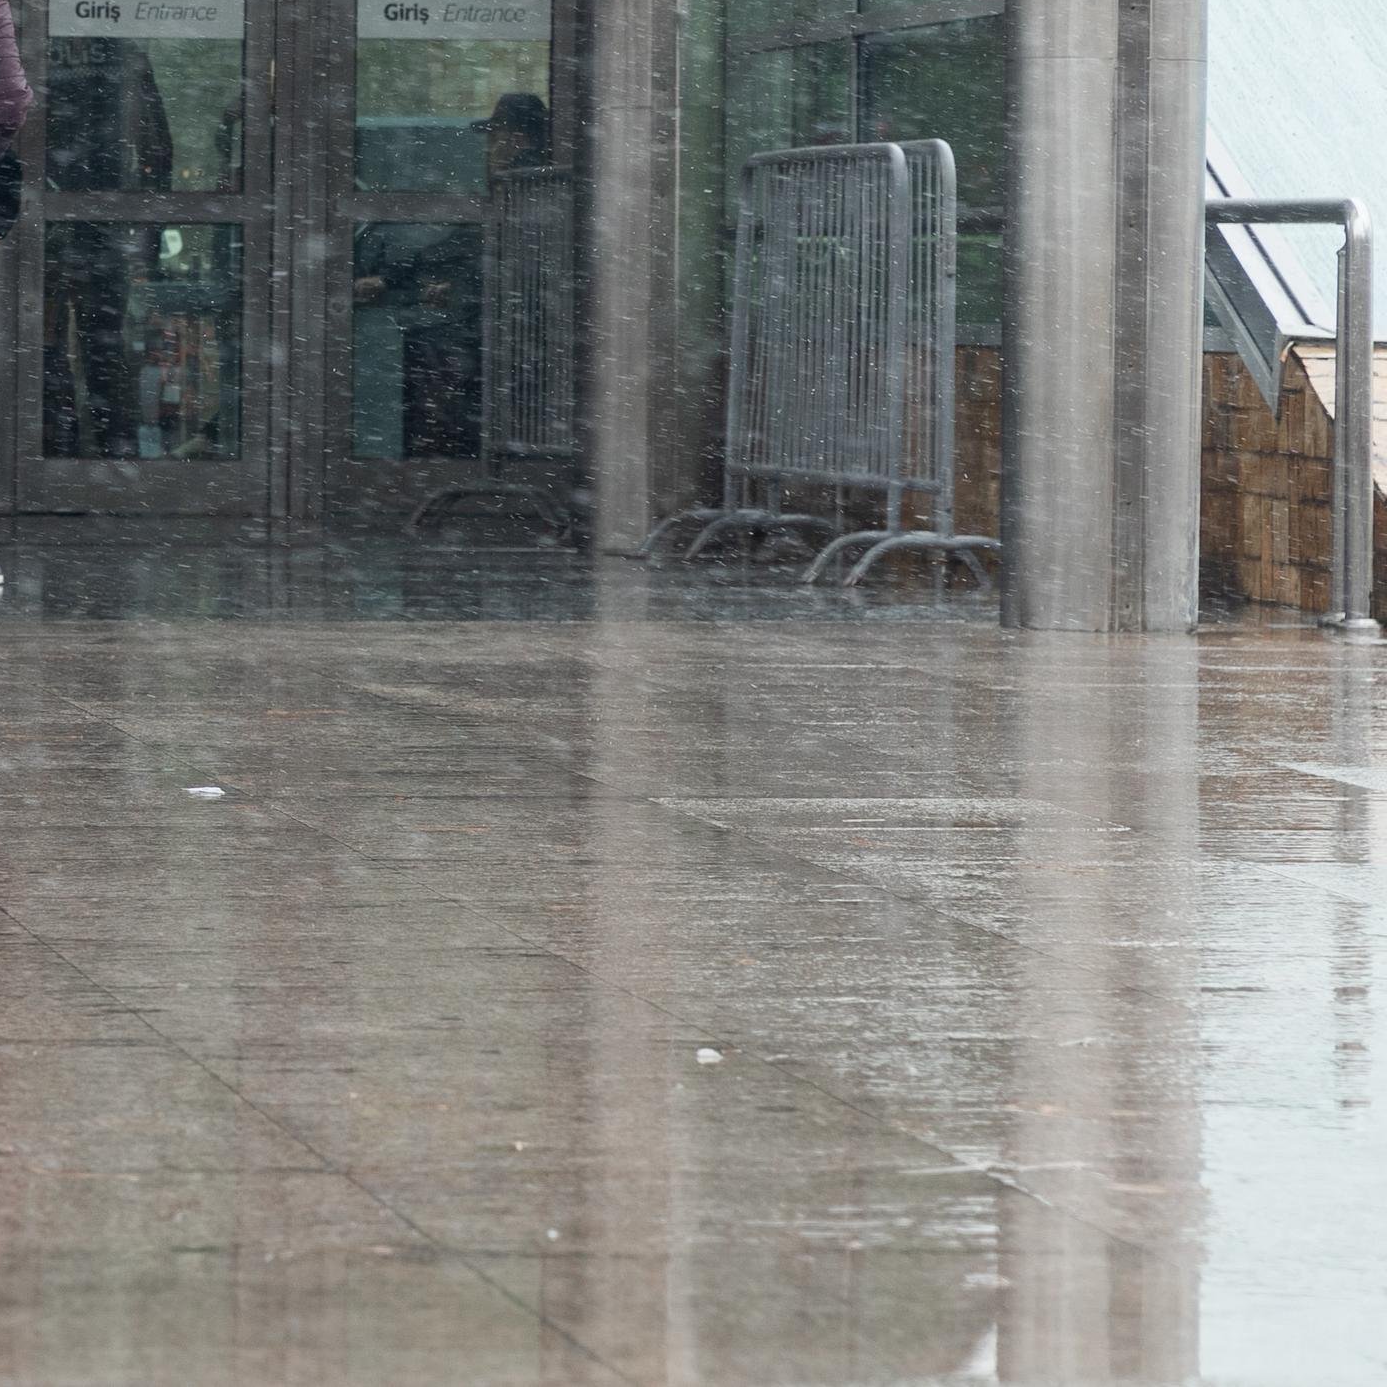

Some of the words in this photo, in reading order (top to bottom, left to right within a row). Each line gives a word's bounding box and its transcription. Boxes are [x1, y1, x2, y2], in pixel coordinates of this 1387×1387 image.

[75, 0, 121, 23] Giriş
[134, 1, 218, 22] Entrance
[384, 3, 430, 25] Giriş
[442, 3, 526, 22] Entrance
